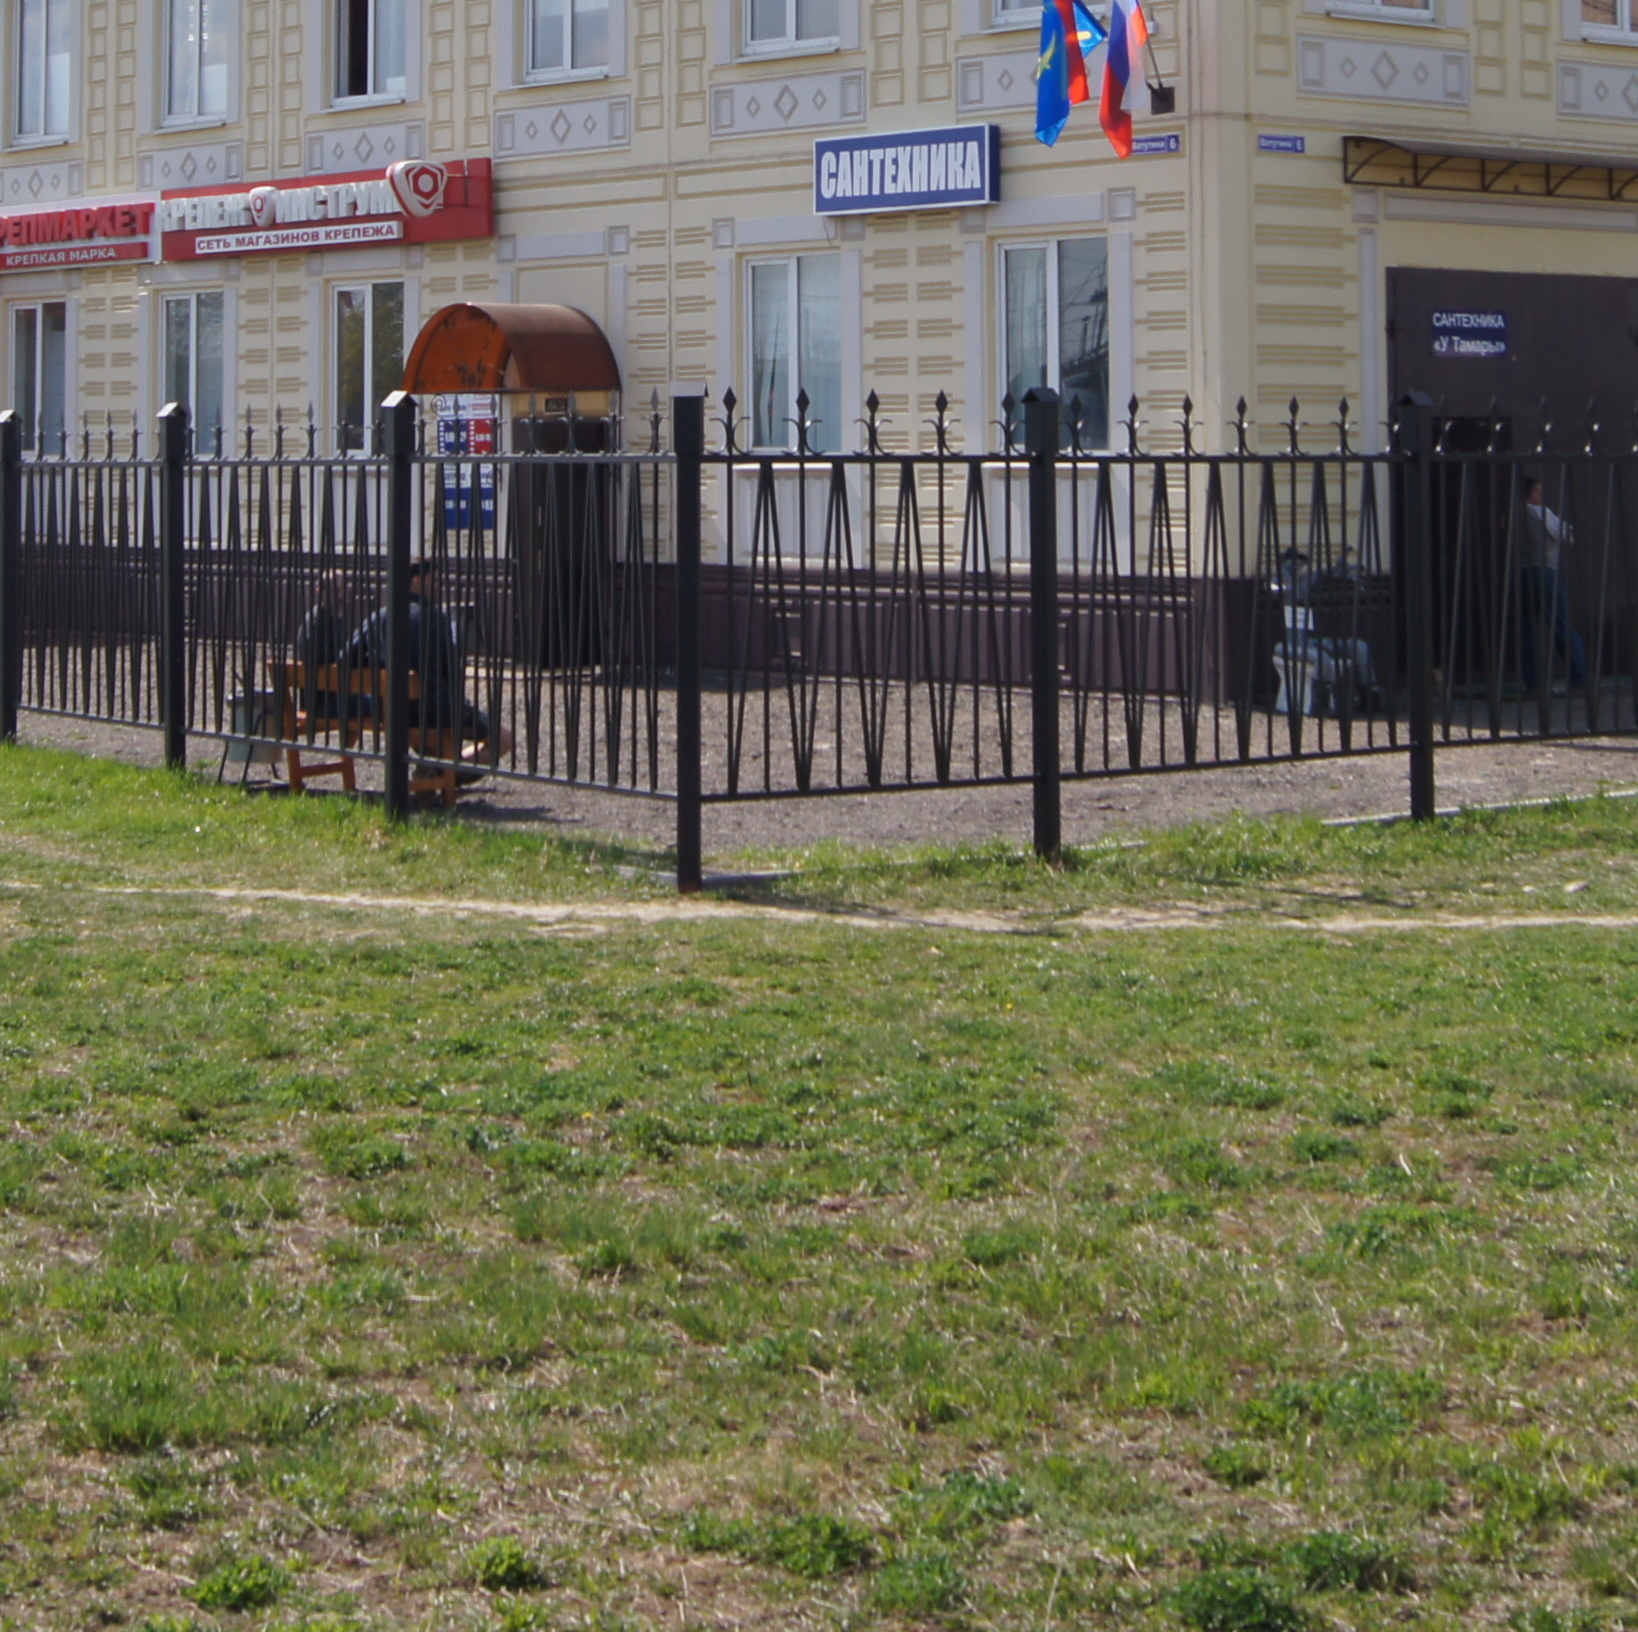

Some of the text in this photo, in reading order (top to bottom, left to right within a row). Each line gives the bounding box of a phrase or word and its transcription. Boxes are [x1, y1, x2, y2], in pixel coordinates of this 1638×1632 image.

[1169, 138, 1177, 149] 6
[820, 141, 981, 199] САНТЕХНИКА
[197, 224, 395, 251] СЕТЬ МАГАЗИНОВ КРЕПЕЖА
[6, 248, 116, 266] КРЕПКАЯ МАРКА
[1433, 312, 1505, 328] САНТЕХНИКА
[1434, 335, 1506, 356] «У Тамары»
